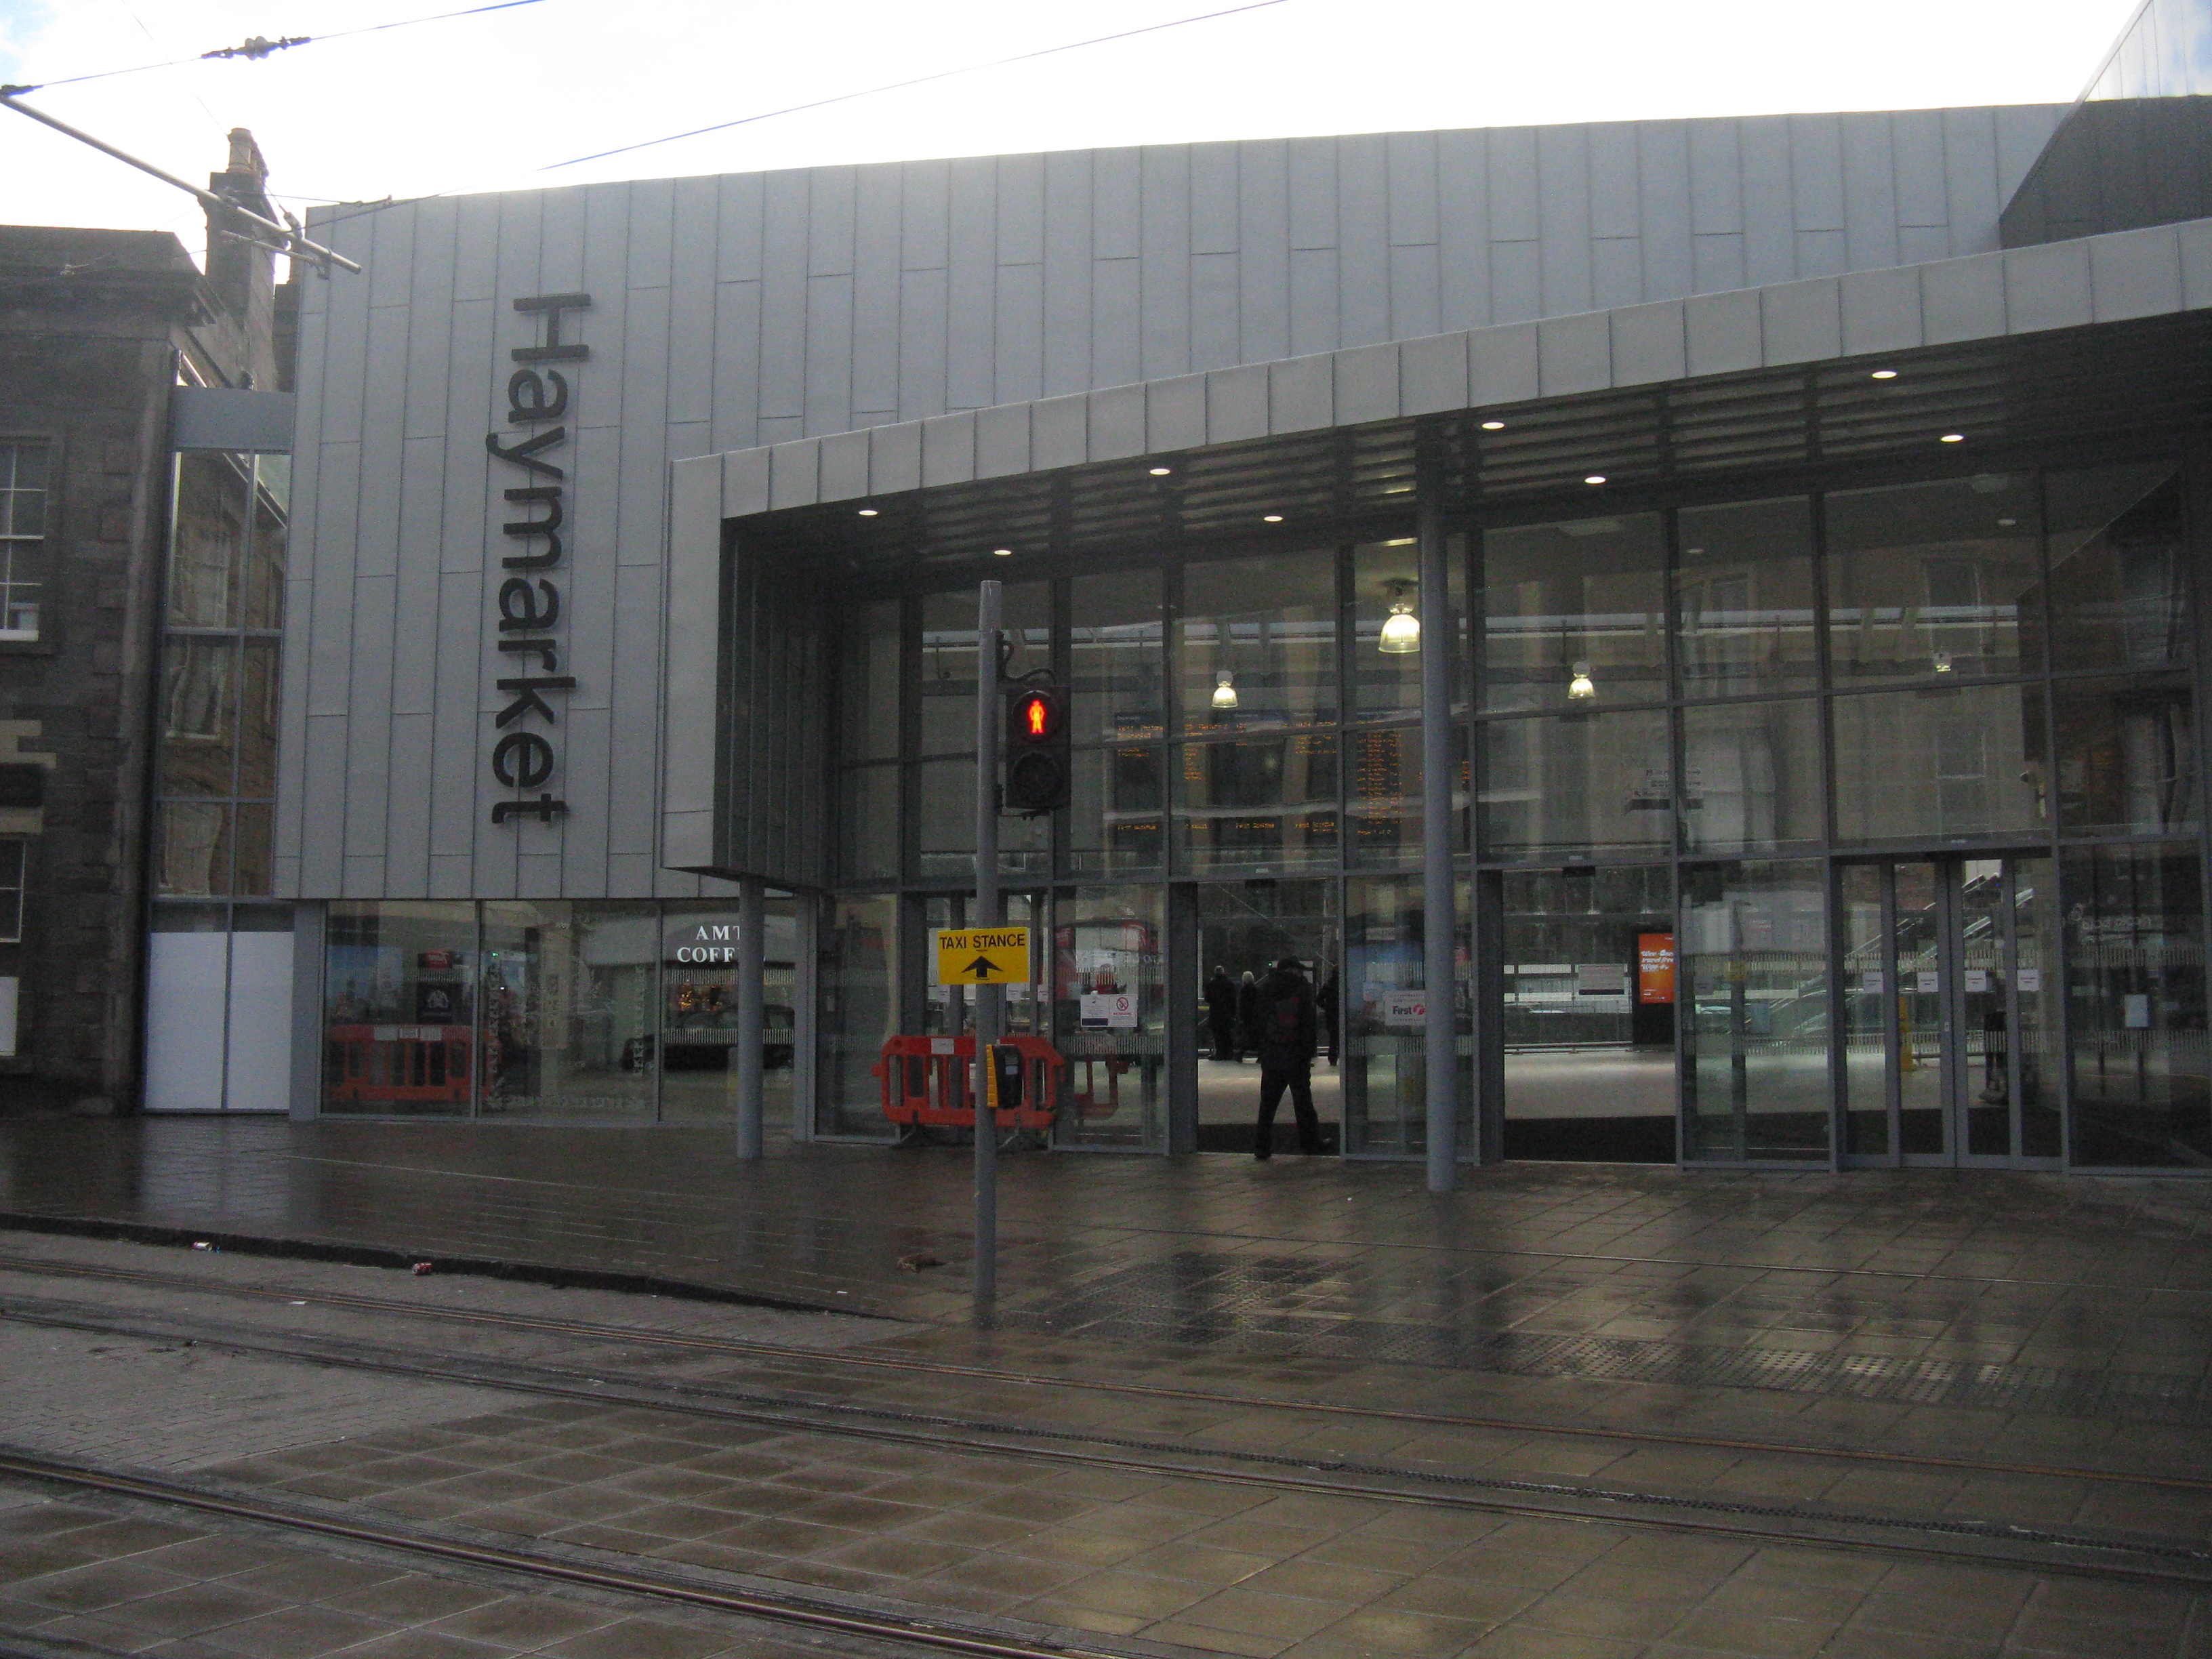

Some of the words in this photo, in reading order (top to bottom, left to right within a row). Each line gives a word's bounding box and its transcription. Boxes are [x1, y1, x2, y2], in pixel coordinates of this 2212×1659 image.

[486, 293, 592, 824] Haymarket
[939, 936, 967, 949] TAXI
[972, 933, 1025, 948] STANCE
[1391, 1005, 1412, 1015] First
